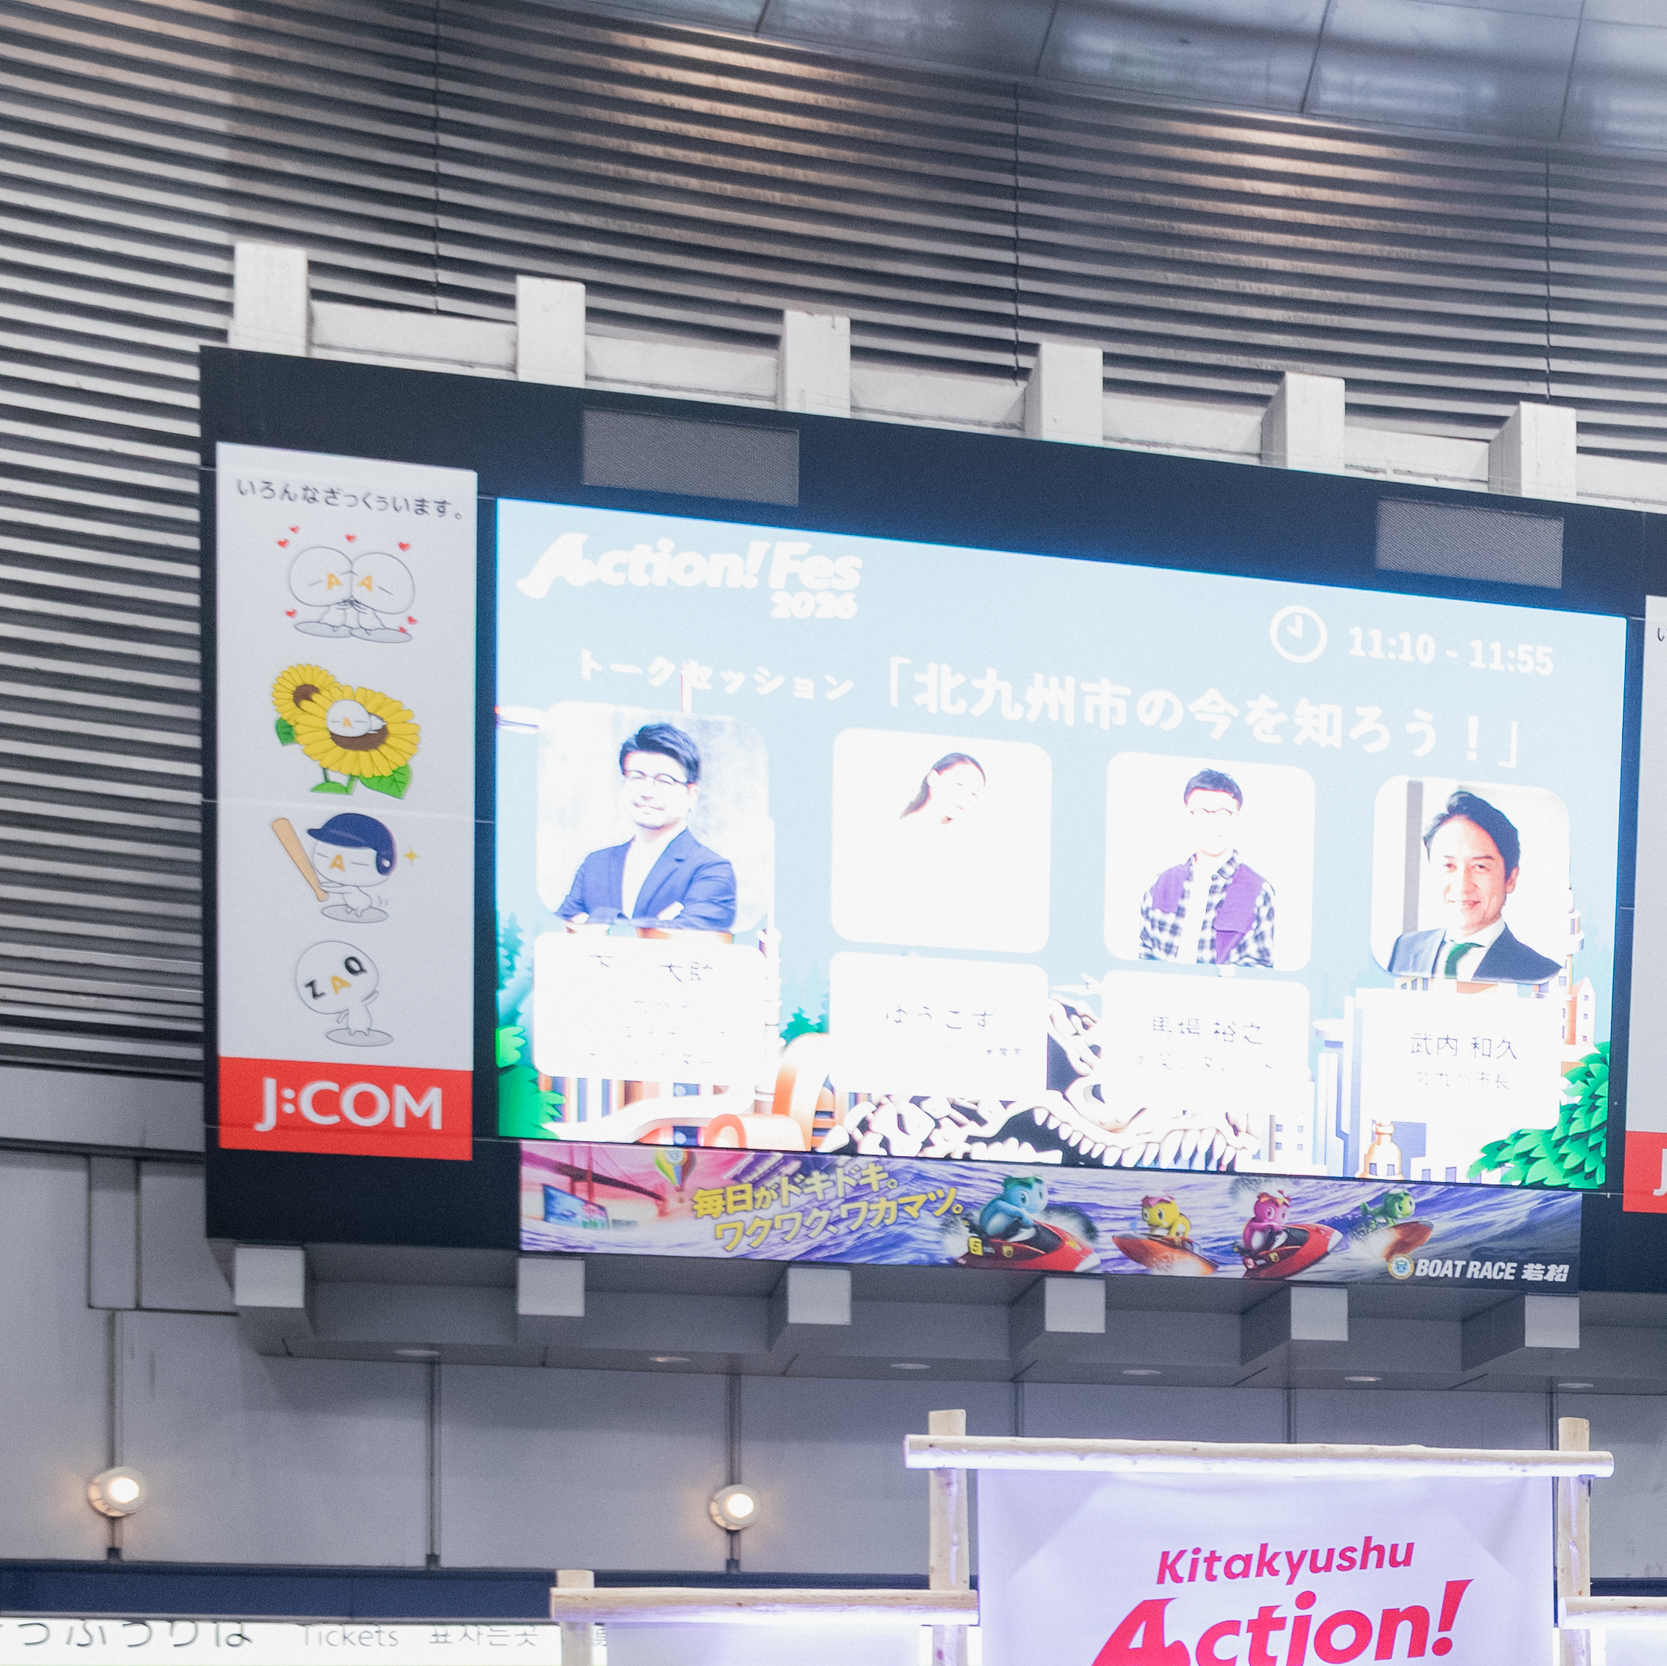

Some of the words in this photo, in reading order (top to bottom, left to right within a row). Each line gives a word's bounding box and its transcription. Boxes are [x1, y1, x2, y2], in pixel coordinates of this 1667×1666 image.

[516, 533, 772, 599] Action!
[768, 540, 863, 591] Fes
[770, 590, 858, 620] 2026
[1348, 626, 1436, 666] 11:10
[1469, 638, 1554, 677] 11:55
[1410, 1032, 1458, 1057] 武内
[1470, 1035, 1518, 1060] 和久
[254, 1077, 443, 1132] J:COM
[692, 1161, 898, 1220] 毎日がドキドキ。
[1414, 1258, 1469, 1280] BOAT
[1470, 1260, 1518, 1281] RACE
[1521, 1262, 1570, 1283] 若松
[1156, 1535, 1415, 1585] Kitakyushu
